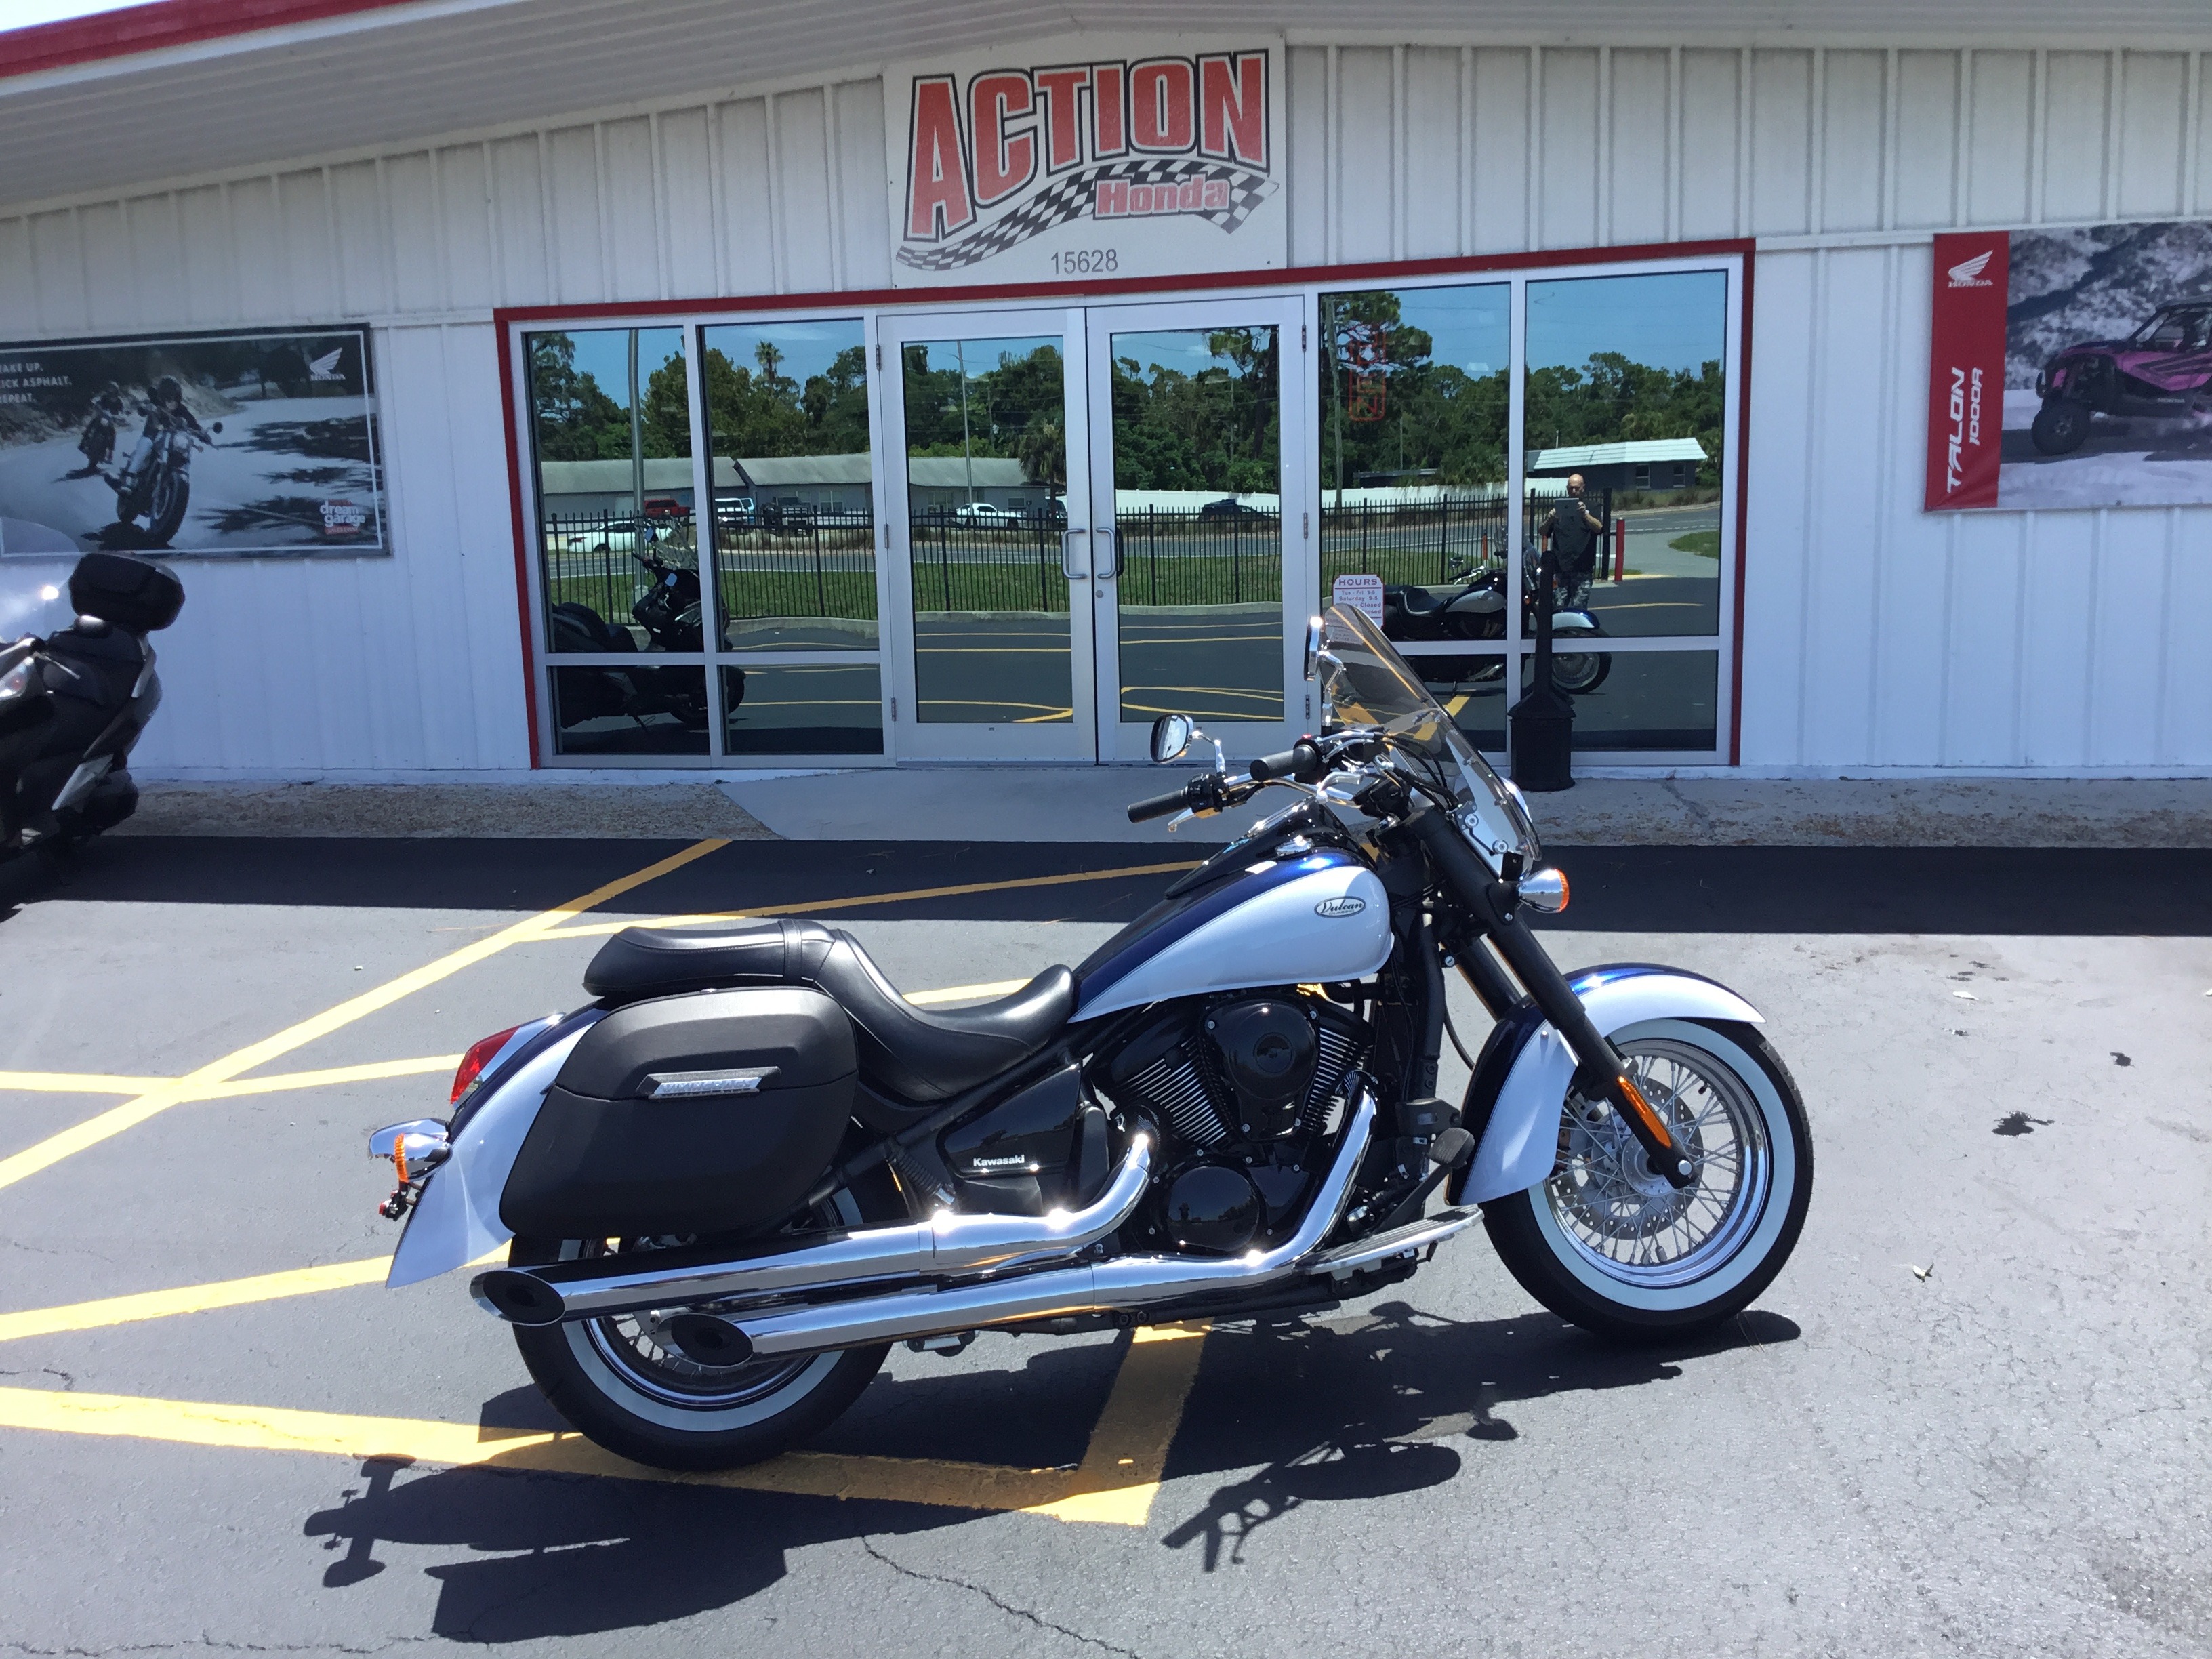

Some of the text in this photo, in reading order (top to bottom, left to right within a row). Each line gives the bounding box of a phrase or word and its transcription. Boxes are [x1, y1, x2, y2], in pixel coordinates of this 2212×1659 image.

[904, 49, 1269, 243] ACTION
[1093, 173, 1230, 220] Honda
[1050, 249, 1118, 274] 15628
[1948, 279, 1993, 287] HONDA
[0, 363, 23, 373] AKE
[0, 379, 19, 388] ICK
[1969, 367, 1983, 445] 1000R
[1946, 367, 1965, 493] TALON
[320, 501, 359, 514] dream
[324, 515, 365, 527] garage
[1338, 578, 1378, 586] HOURS
[1320, 899, 1362, 914] Vulcan
[973, 1155, 1025, 1166] Kawasaki
